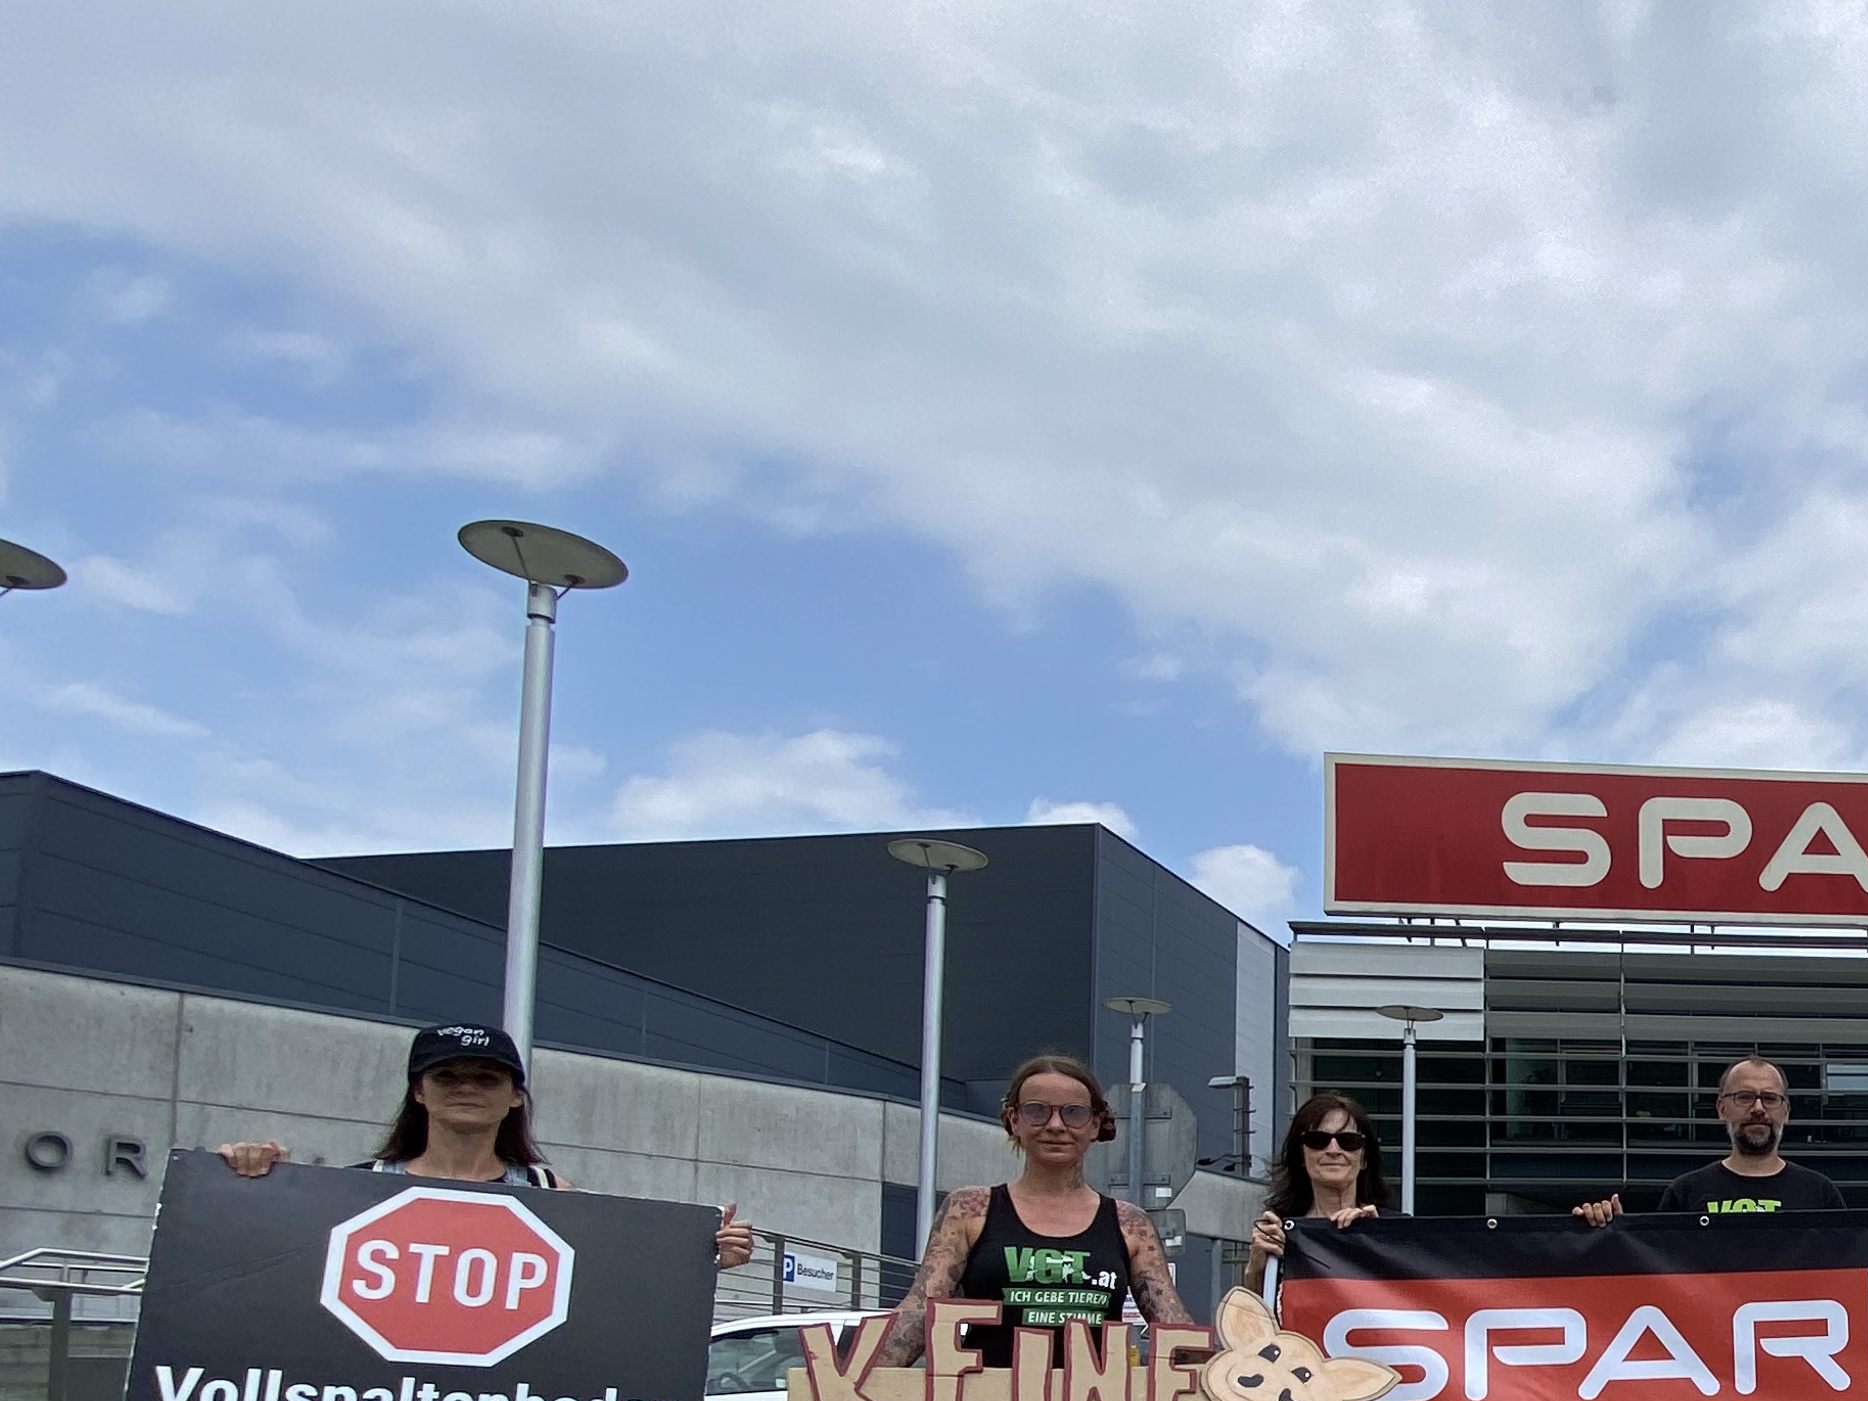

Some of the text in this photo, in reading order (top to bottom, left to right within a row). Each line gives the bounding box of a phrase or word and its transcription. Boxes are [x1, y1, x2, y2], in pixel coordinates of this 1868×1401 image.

[461, 1035, 490, 1046] girl
[352, 1241, 548, 1310] STOP
[797, 1263, 834, 1280] Besucher
[1010, 1291, 1108, 1304] ICH GEBE TIEREN
[1028, 1311, 1056, 1323] EINE
